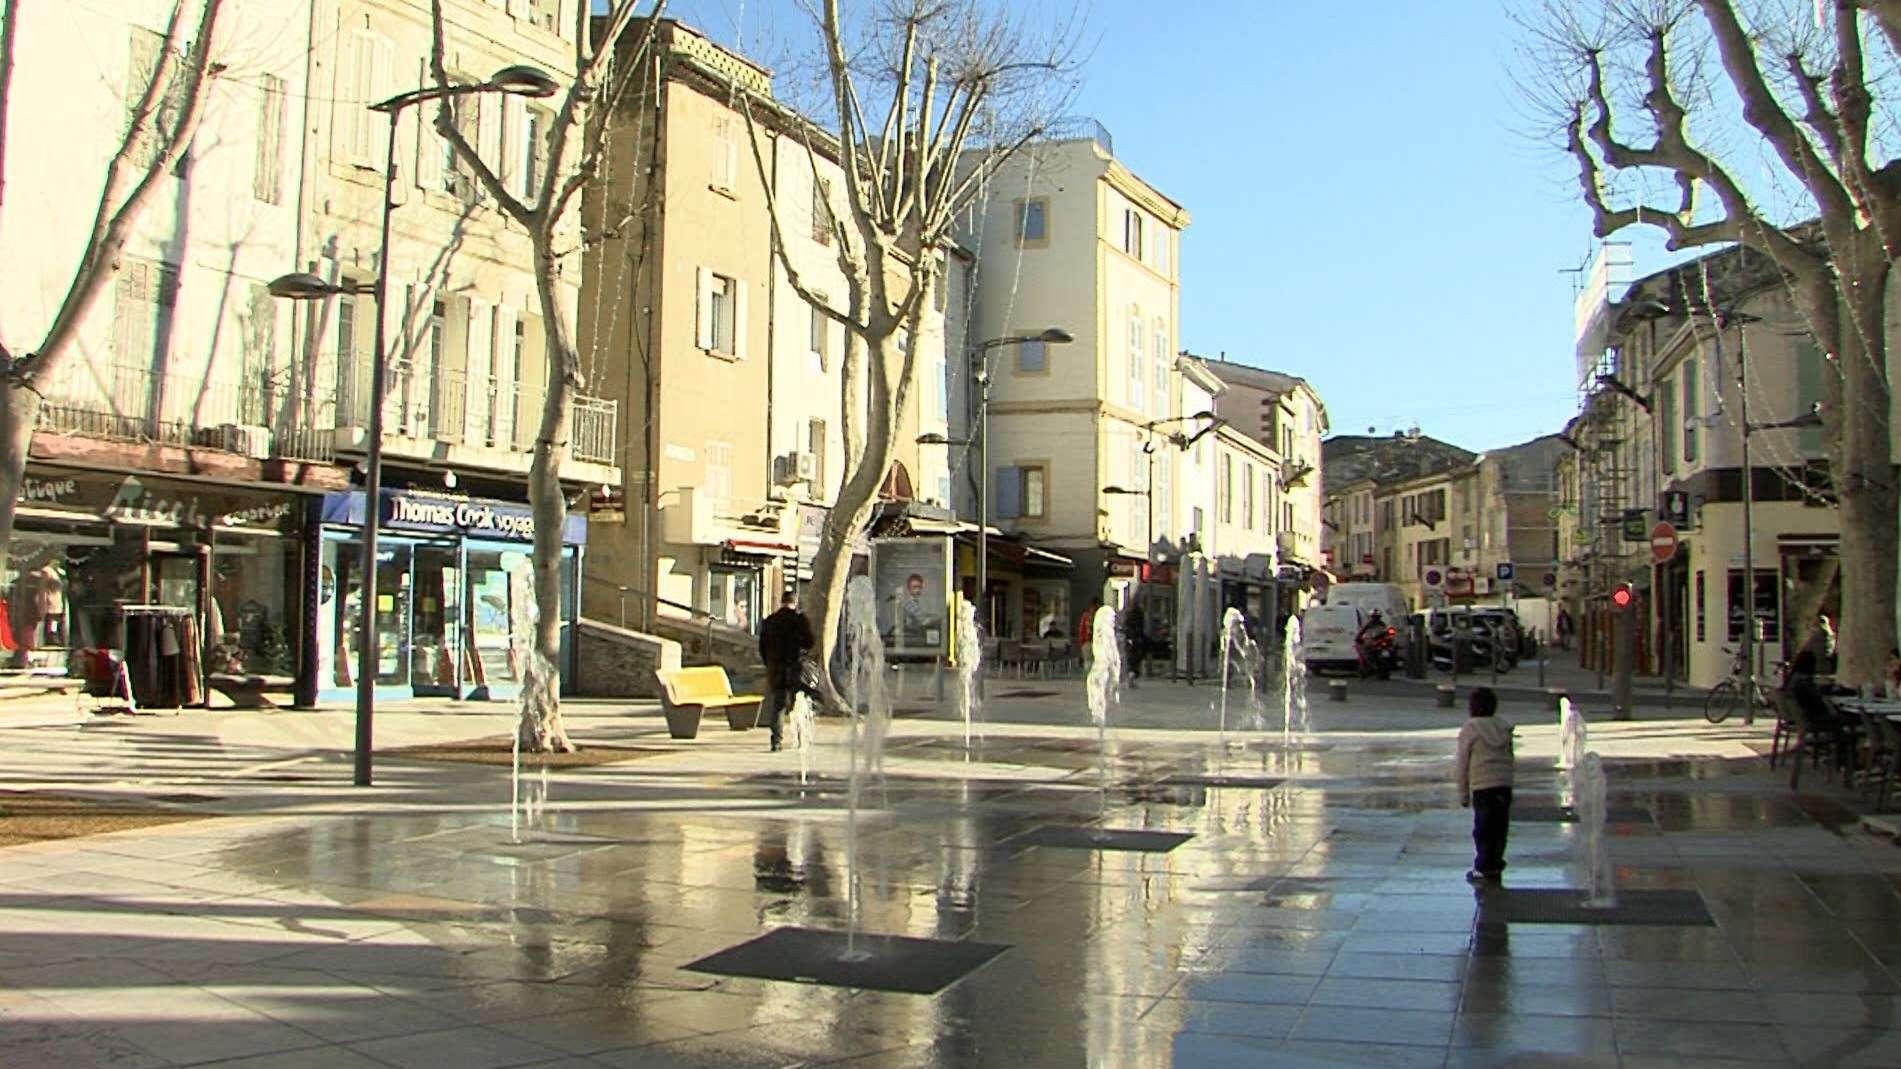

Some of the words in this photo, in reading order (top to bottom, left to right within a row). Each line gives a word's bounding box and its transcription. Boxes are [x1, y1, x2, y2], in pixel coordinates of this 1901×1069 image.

[392, 497, 455, 526] Thomas
[456, 502, 495, 529] Cook
[495, 514, 536, 539] voyag
